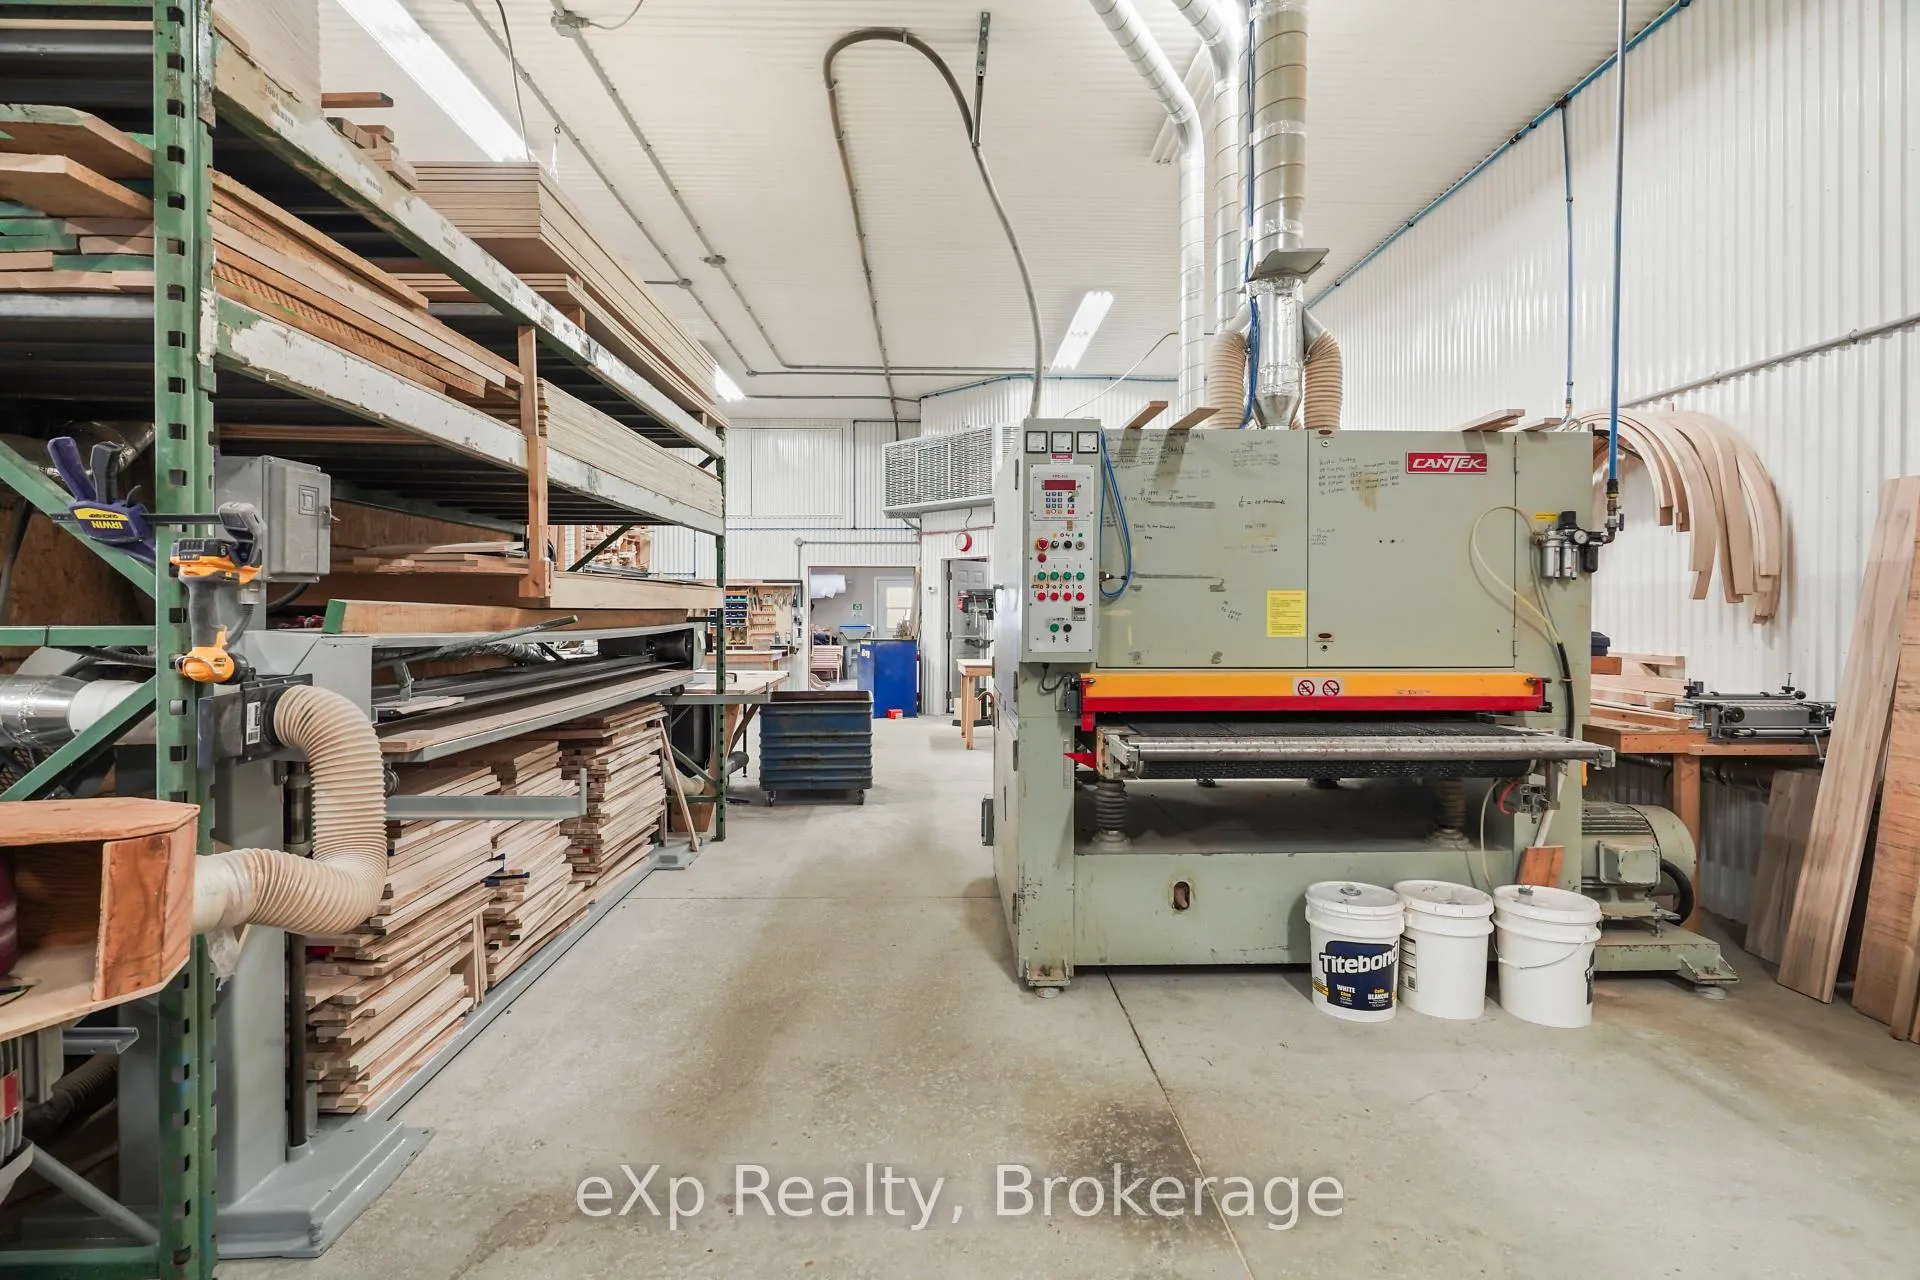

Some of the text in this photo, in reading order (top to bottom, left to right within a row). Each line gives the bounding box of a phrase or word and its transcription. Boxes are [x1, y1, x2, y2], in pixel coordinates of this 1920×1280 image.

[1412, 455, 1487, 472] CANTEK
[90, 520, 124, 529] IRWIN
[1320, 942, 1398, 974] Titebond
[1336, 984, 1356, 994] WHITE
